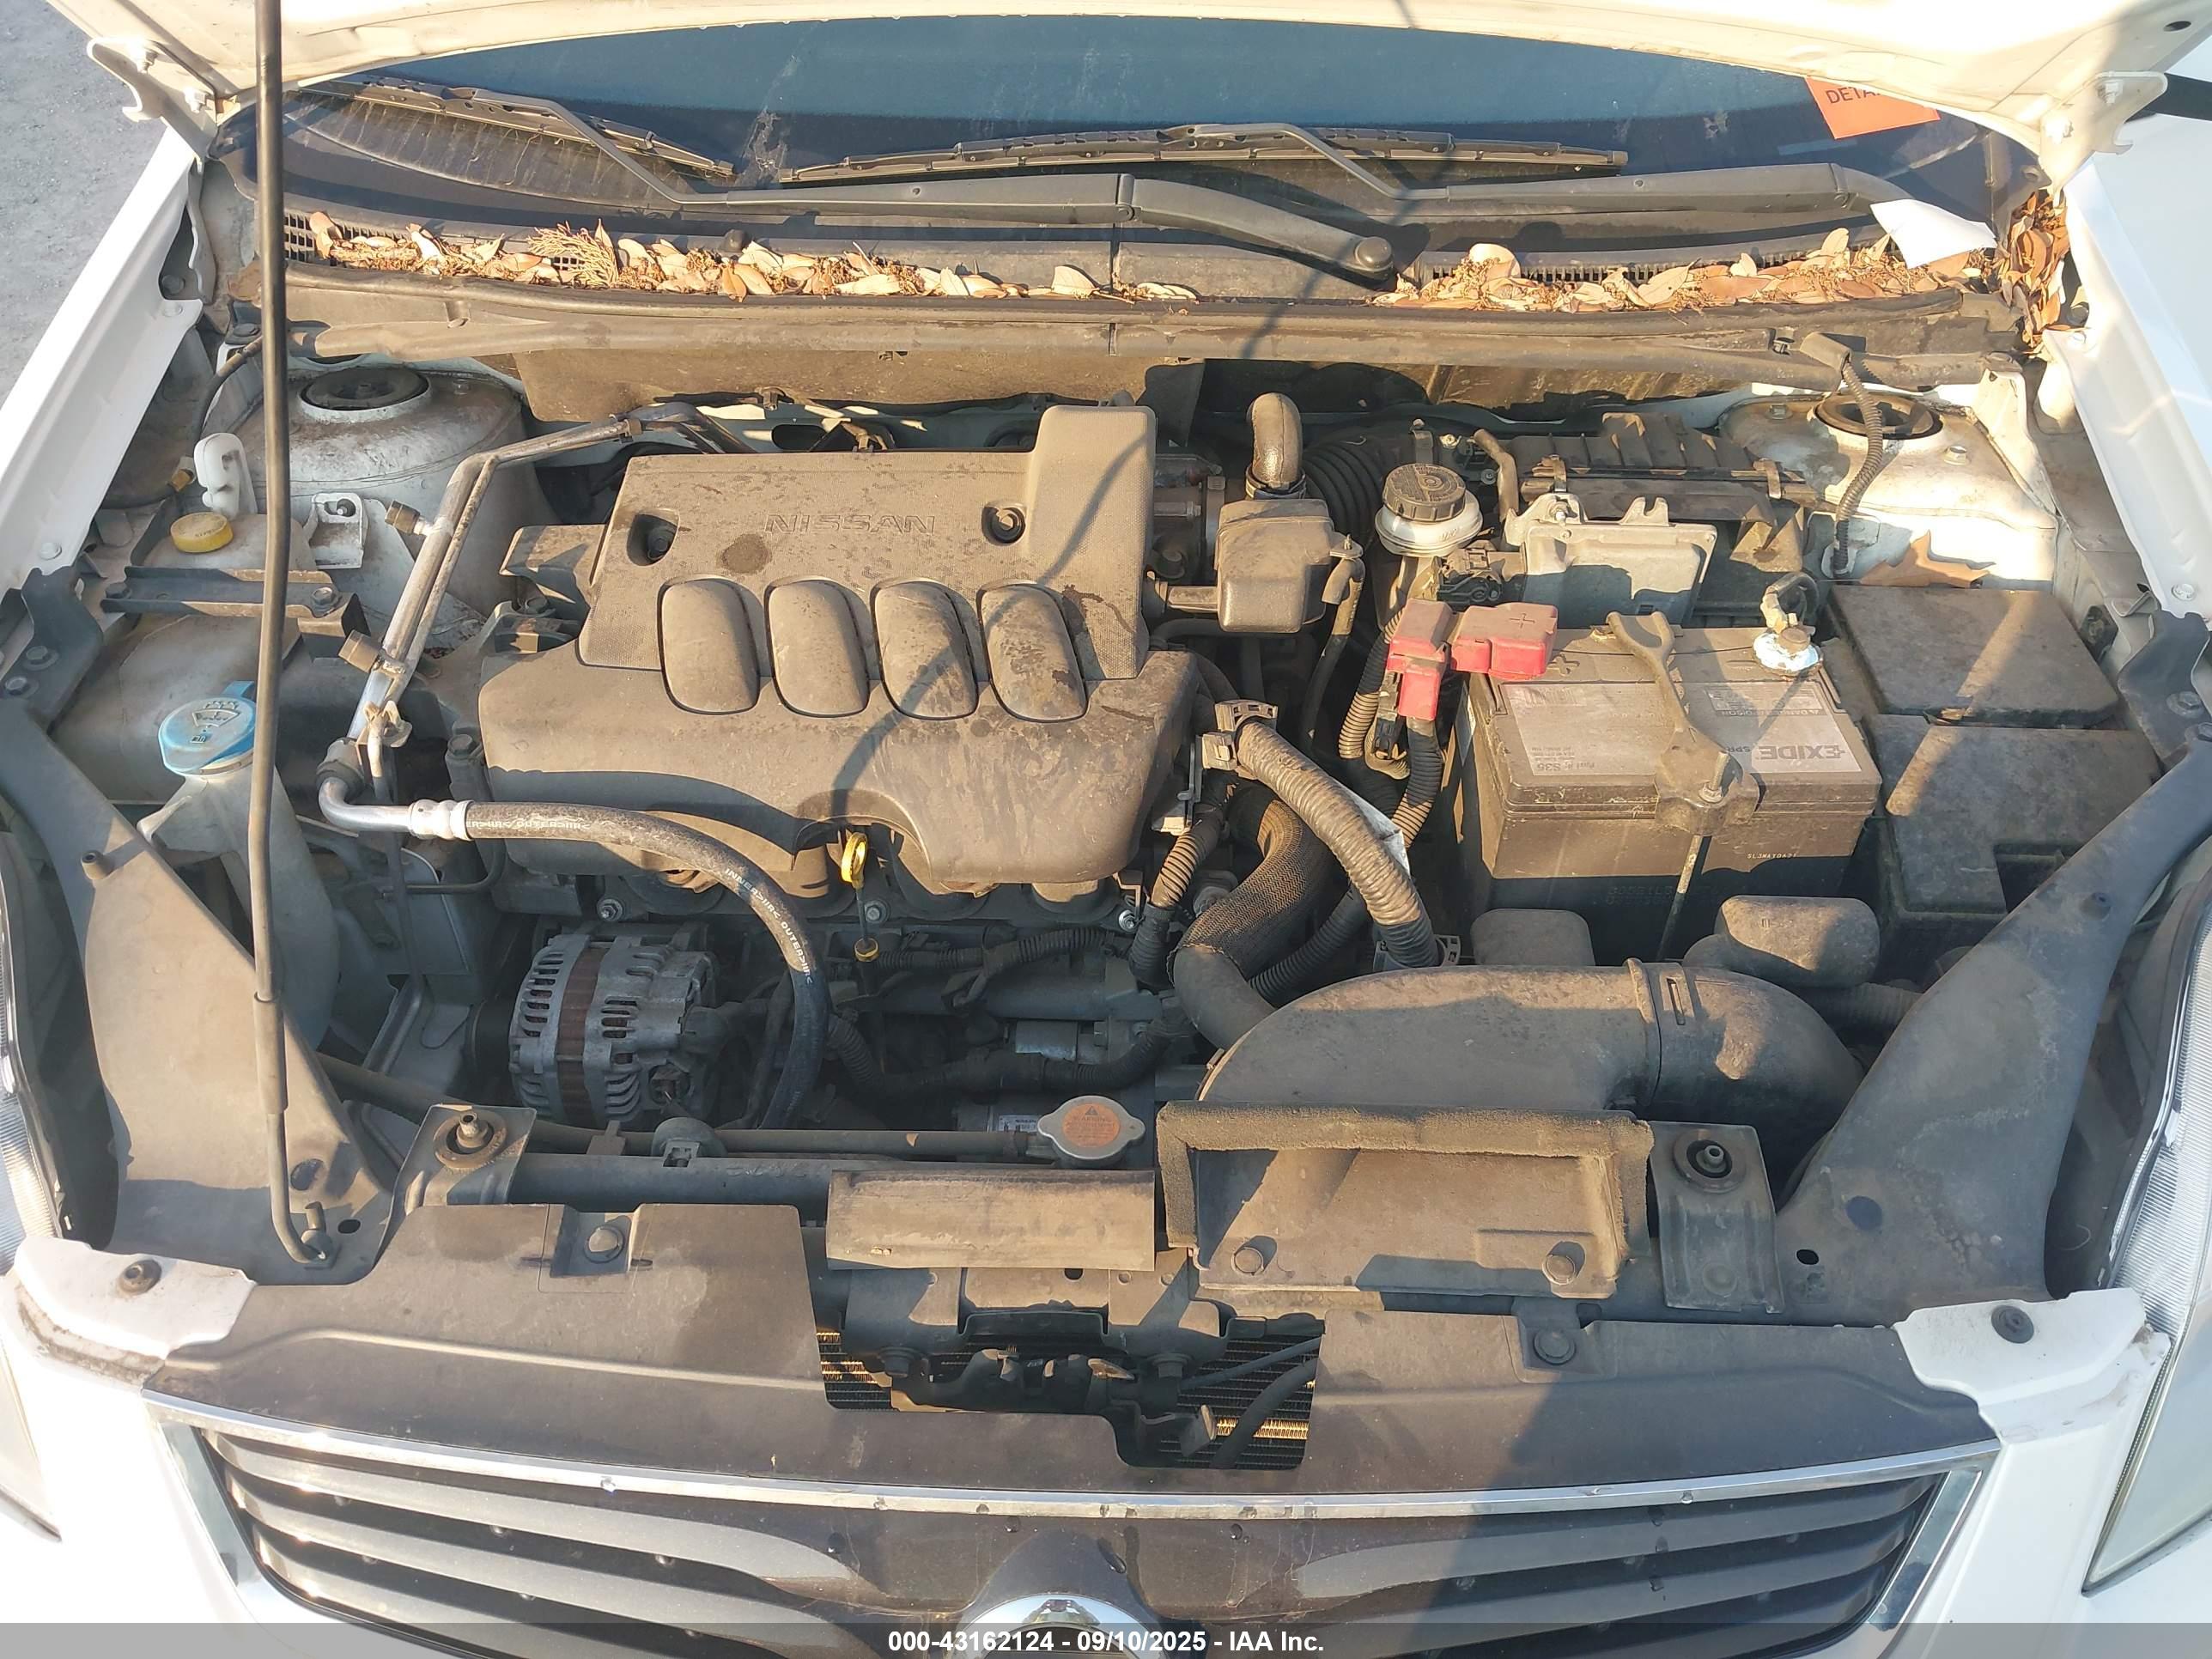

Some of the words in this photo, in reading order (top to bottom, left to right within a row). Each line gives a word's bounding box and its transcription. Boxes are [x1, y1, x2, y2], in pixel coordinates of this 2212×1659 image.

[764, 515, 935, 534] NISSAN
[1757, 744, 1845, 761] EXIDE
[1537, 763, 1561, 771] S35
